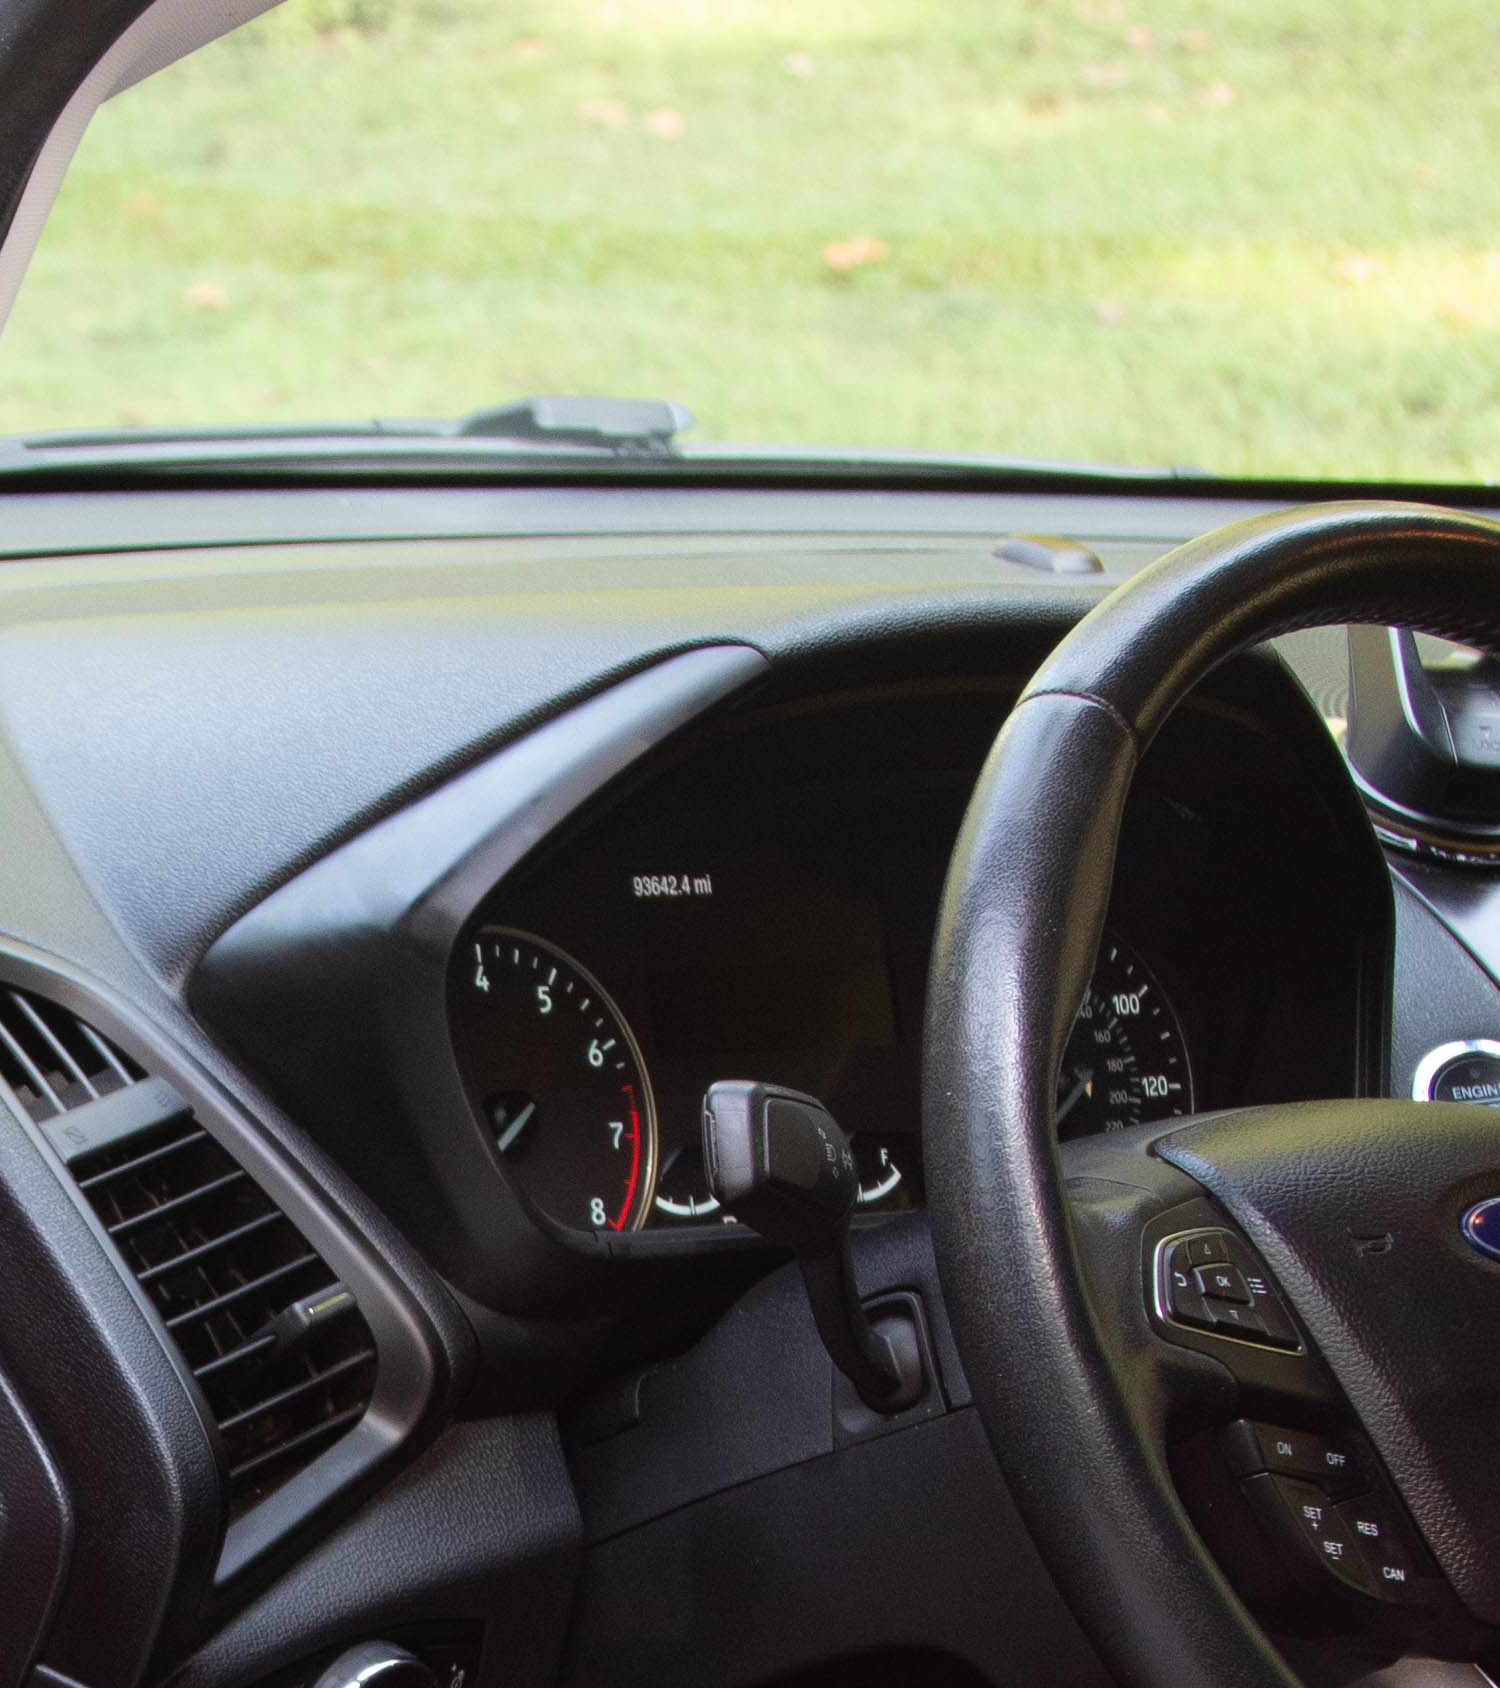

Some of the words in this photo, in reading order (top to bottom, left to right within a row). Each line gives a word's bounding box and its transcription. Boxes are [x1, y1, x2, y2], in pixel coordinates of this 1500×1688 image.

[633, 875, 691, 897] 93642.4
[693, 874, 713, 896] mi
[475, 966, 491, 992] 4
[537, 985, 553, 1014] 5
[1112, 993, 1140, 1015] 100
[588, 1039, 604, 1067] 6
[1142, 1075, 1168, 1097] 120
[608, 1121, 624, 1149] 7
[880, 1147, 889, 1168] F
[589, 1198, 606, 1226] 8
[1277, 1441, 1293, 1456] ON
[1326, 1453, 1347, 1467] OFF
[1303, 1505, 1322, 1520] SET
[1357, 1521, 1379, 1536] RES
[1323, 1541, 1344, 1556] SET
[1383, 1566, 1406, 1581] CAN
